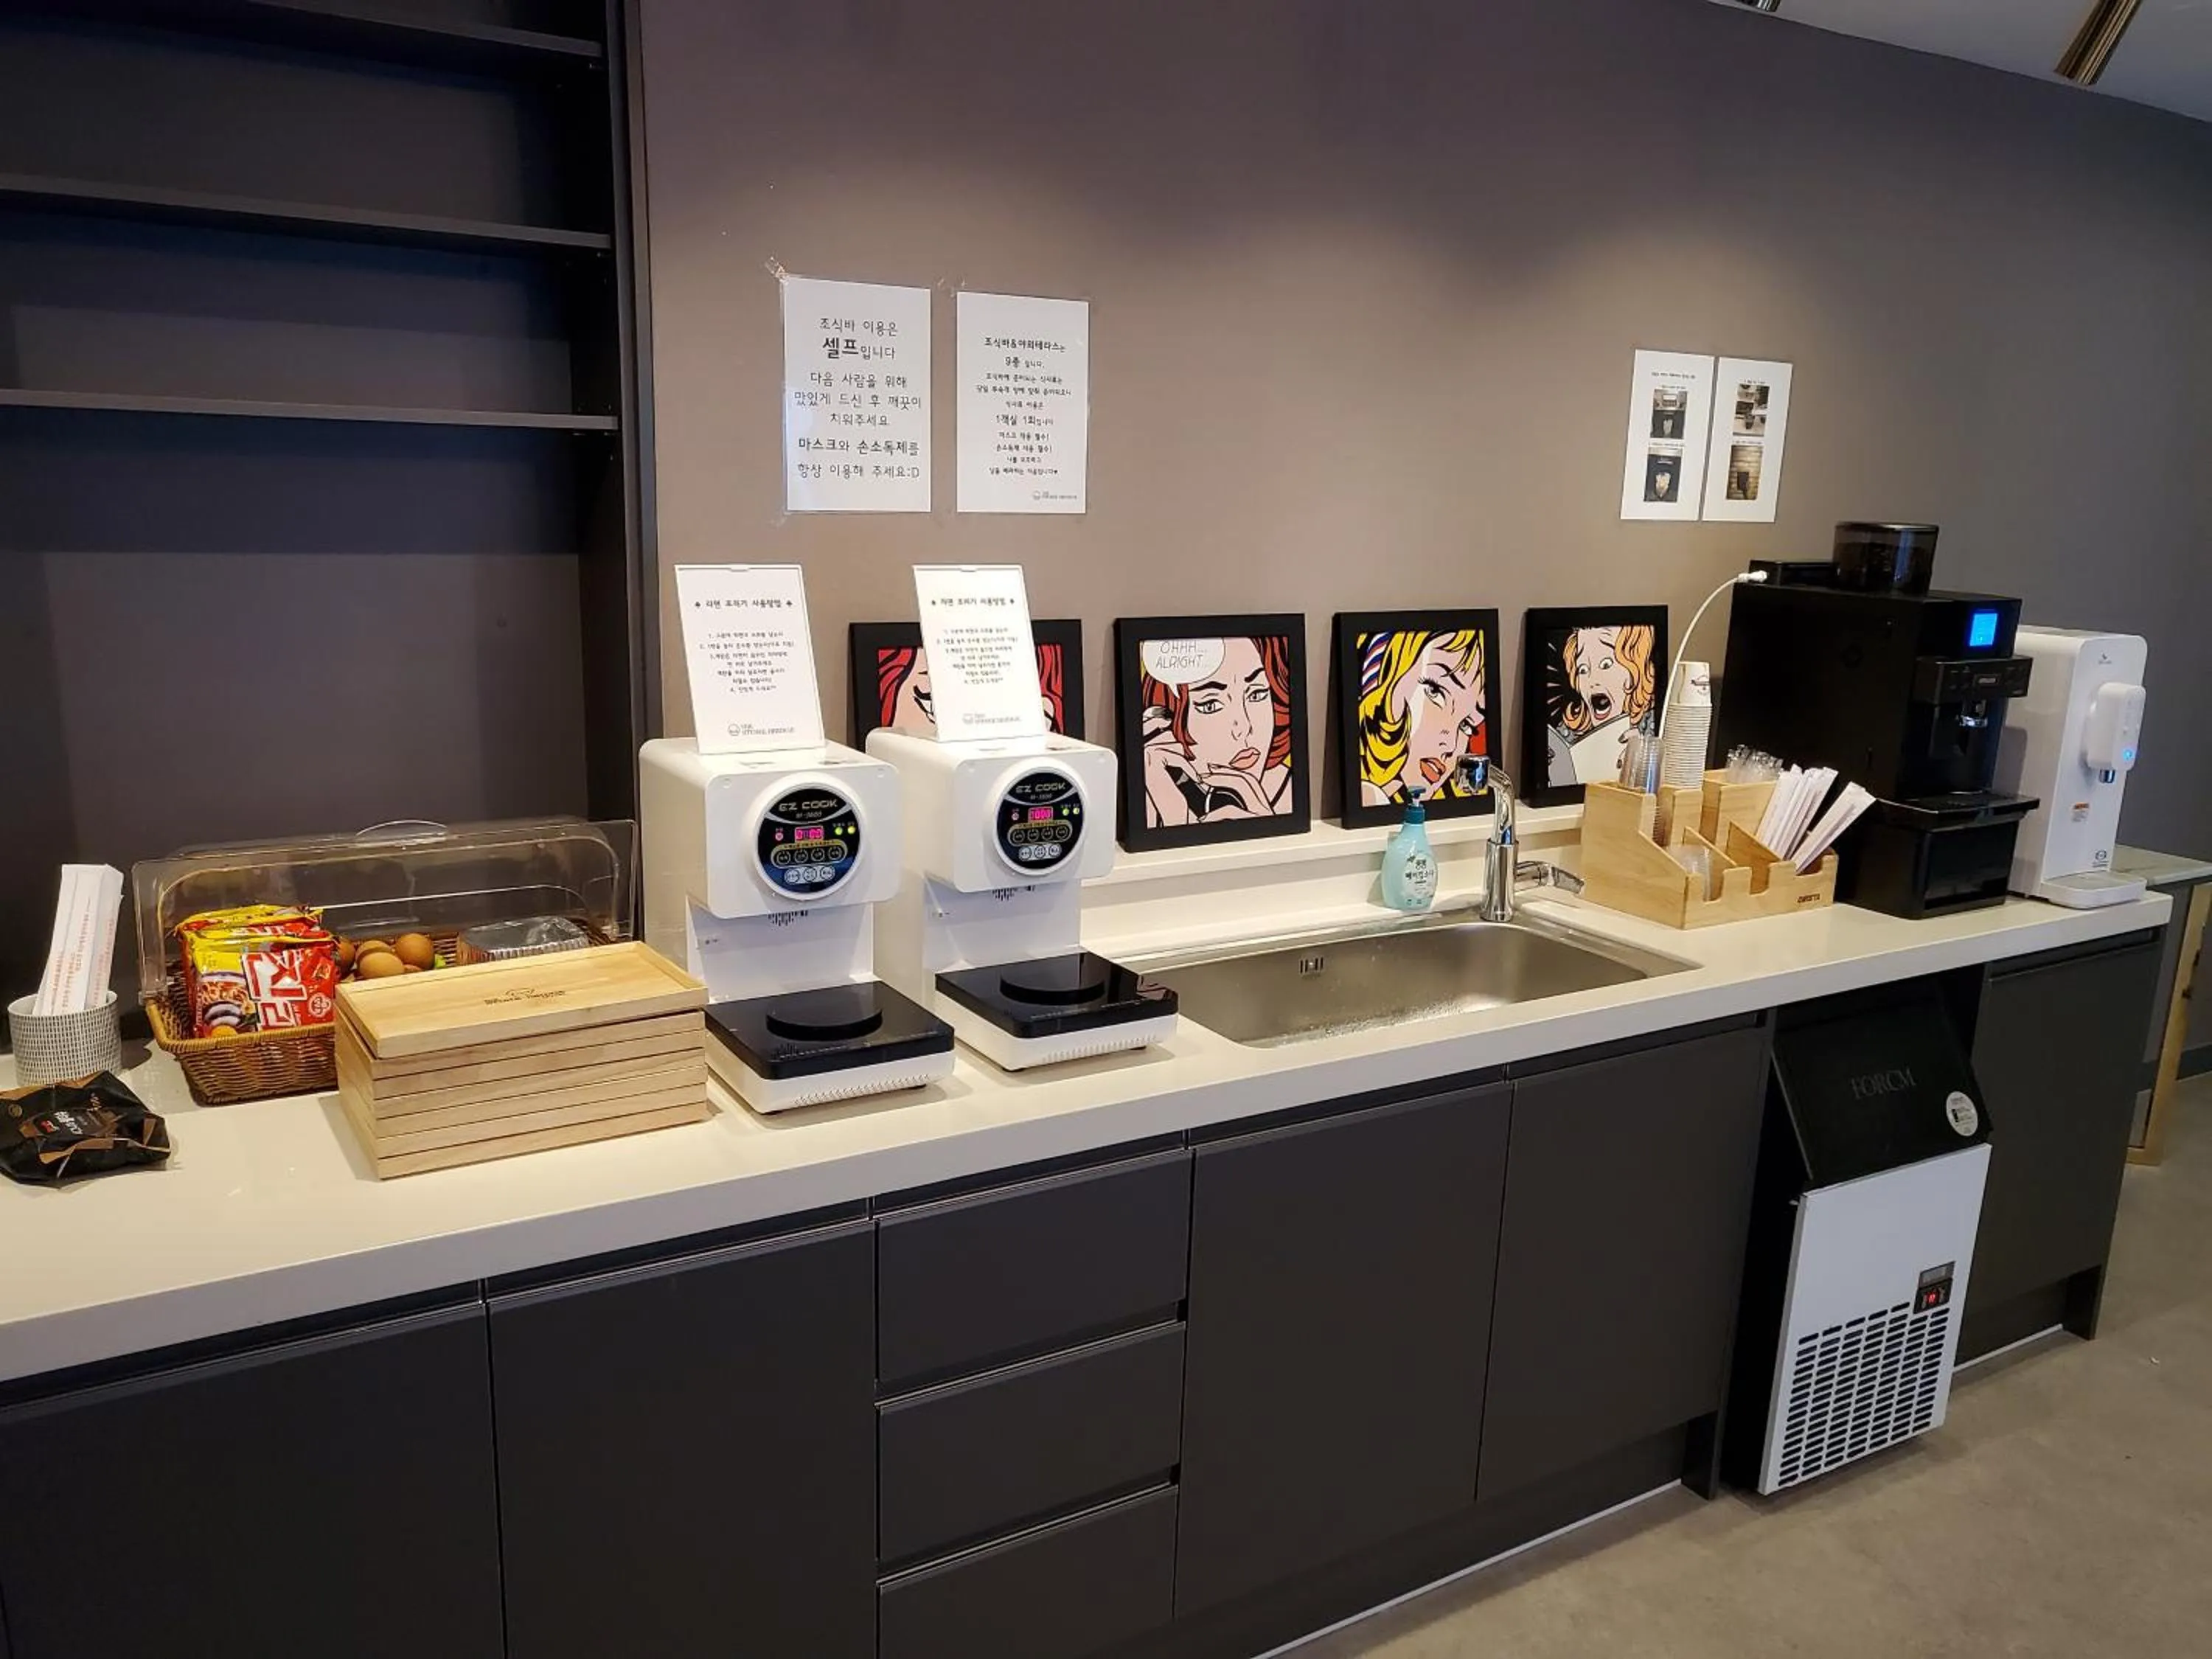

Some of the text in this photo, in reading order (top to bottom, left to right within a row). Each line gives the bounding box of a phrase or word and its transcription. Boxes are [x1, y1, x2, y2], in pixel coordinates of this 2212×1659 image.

[819, 318, 898, 337] 조식바 이용은
[822, 337, 896, 360] 셀프입니다
[810, 372, 907, 389] 다음 사람을 위해
[794, 392, 922, 411] 맛있게 드신 후 깨끗이
[830, 413, 889, 426] 치워주세요
[799, 437, 920, 456] 마스크와 손소독제를
[797, 463, 920, 479] 항상 이용해 주세요:D
[1035, 782, 1067, 793] COOK
[801, 799, 838, 810] COOK
